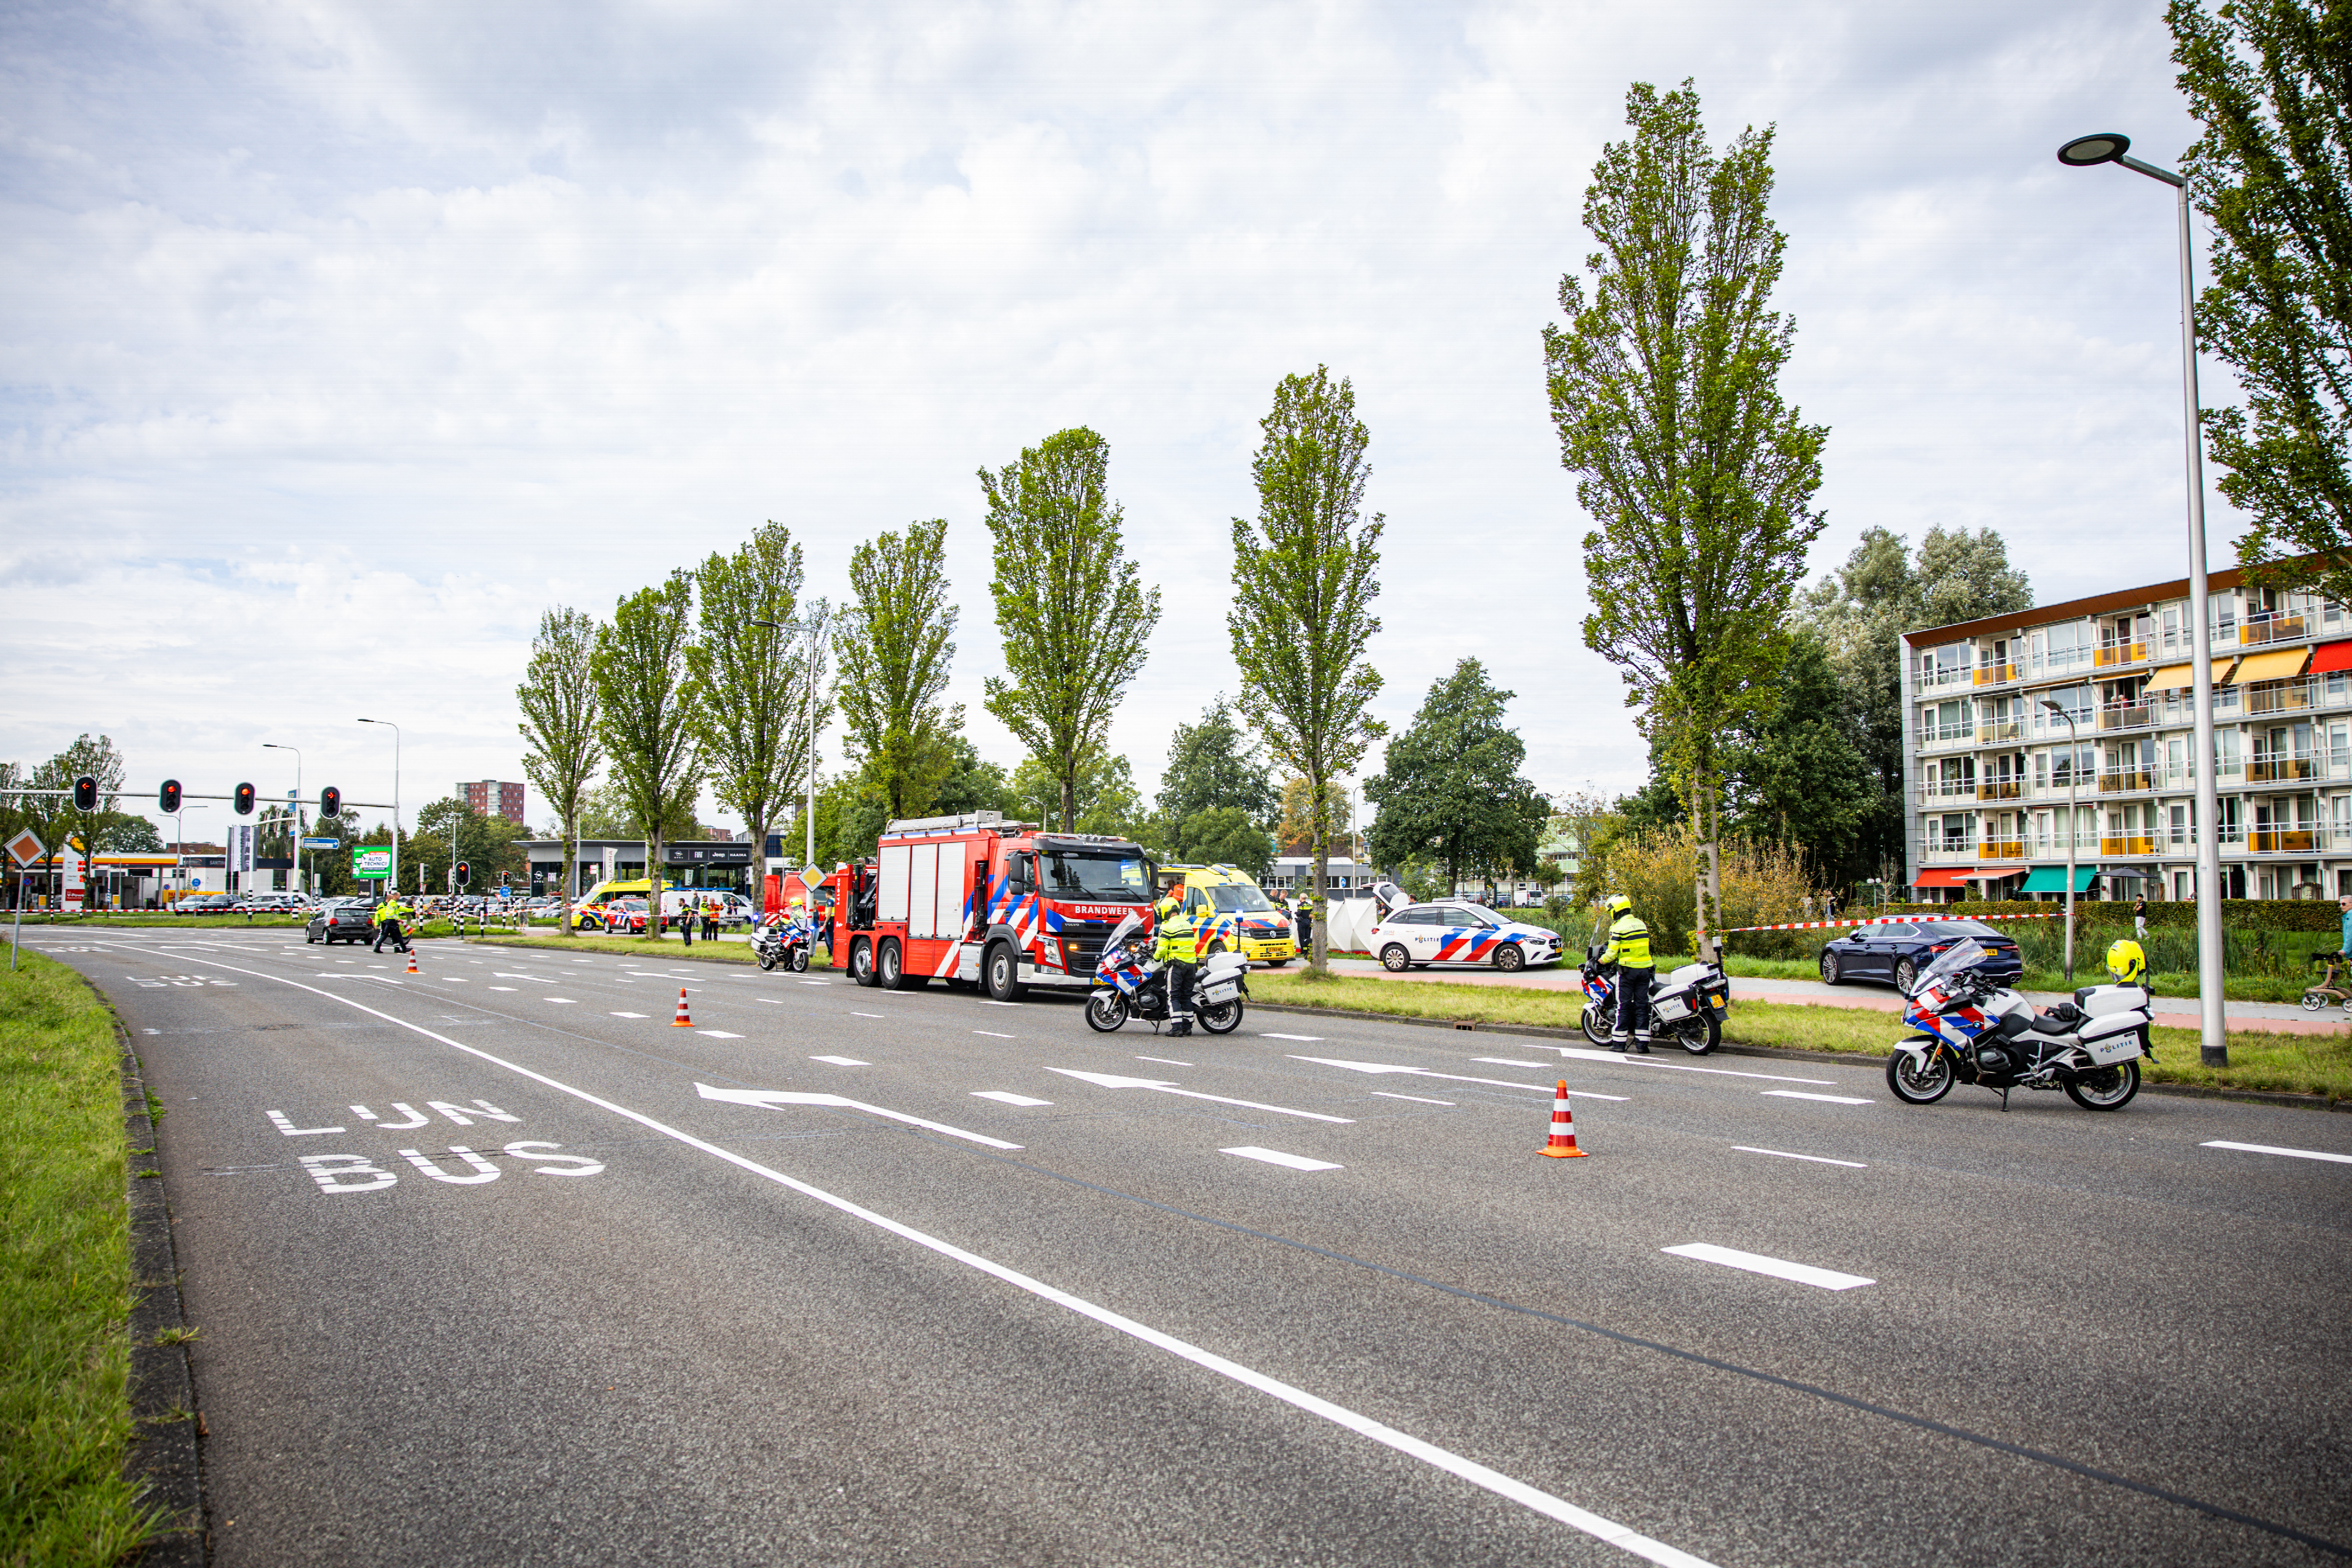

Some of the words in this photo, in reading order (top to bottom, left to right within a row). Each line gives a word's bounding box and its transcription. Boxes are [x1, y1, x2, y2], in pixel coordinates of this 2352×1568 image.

[547, 872, 557, 882] FIAT
[1212, 987, 1232, 996] POLITIE
[1662, 1003, 1681, 1013] POLITIE
[2100, 1039, 2133, 1053] POLITIE
[265, 1099, 523, 1136] LIJN
[298, 1141, 606, 1194] BUS
